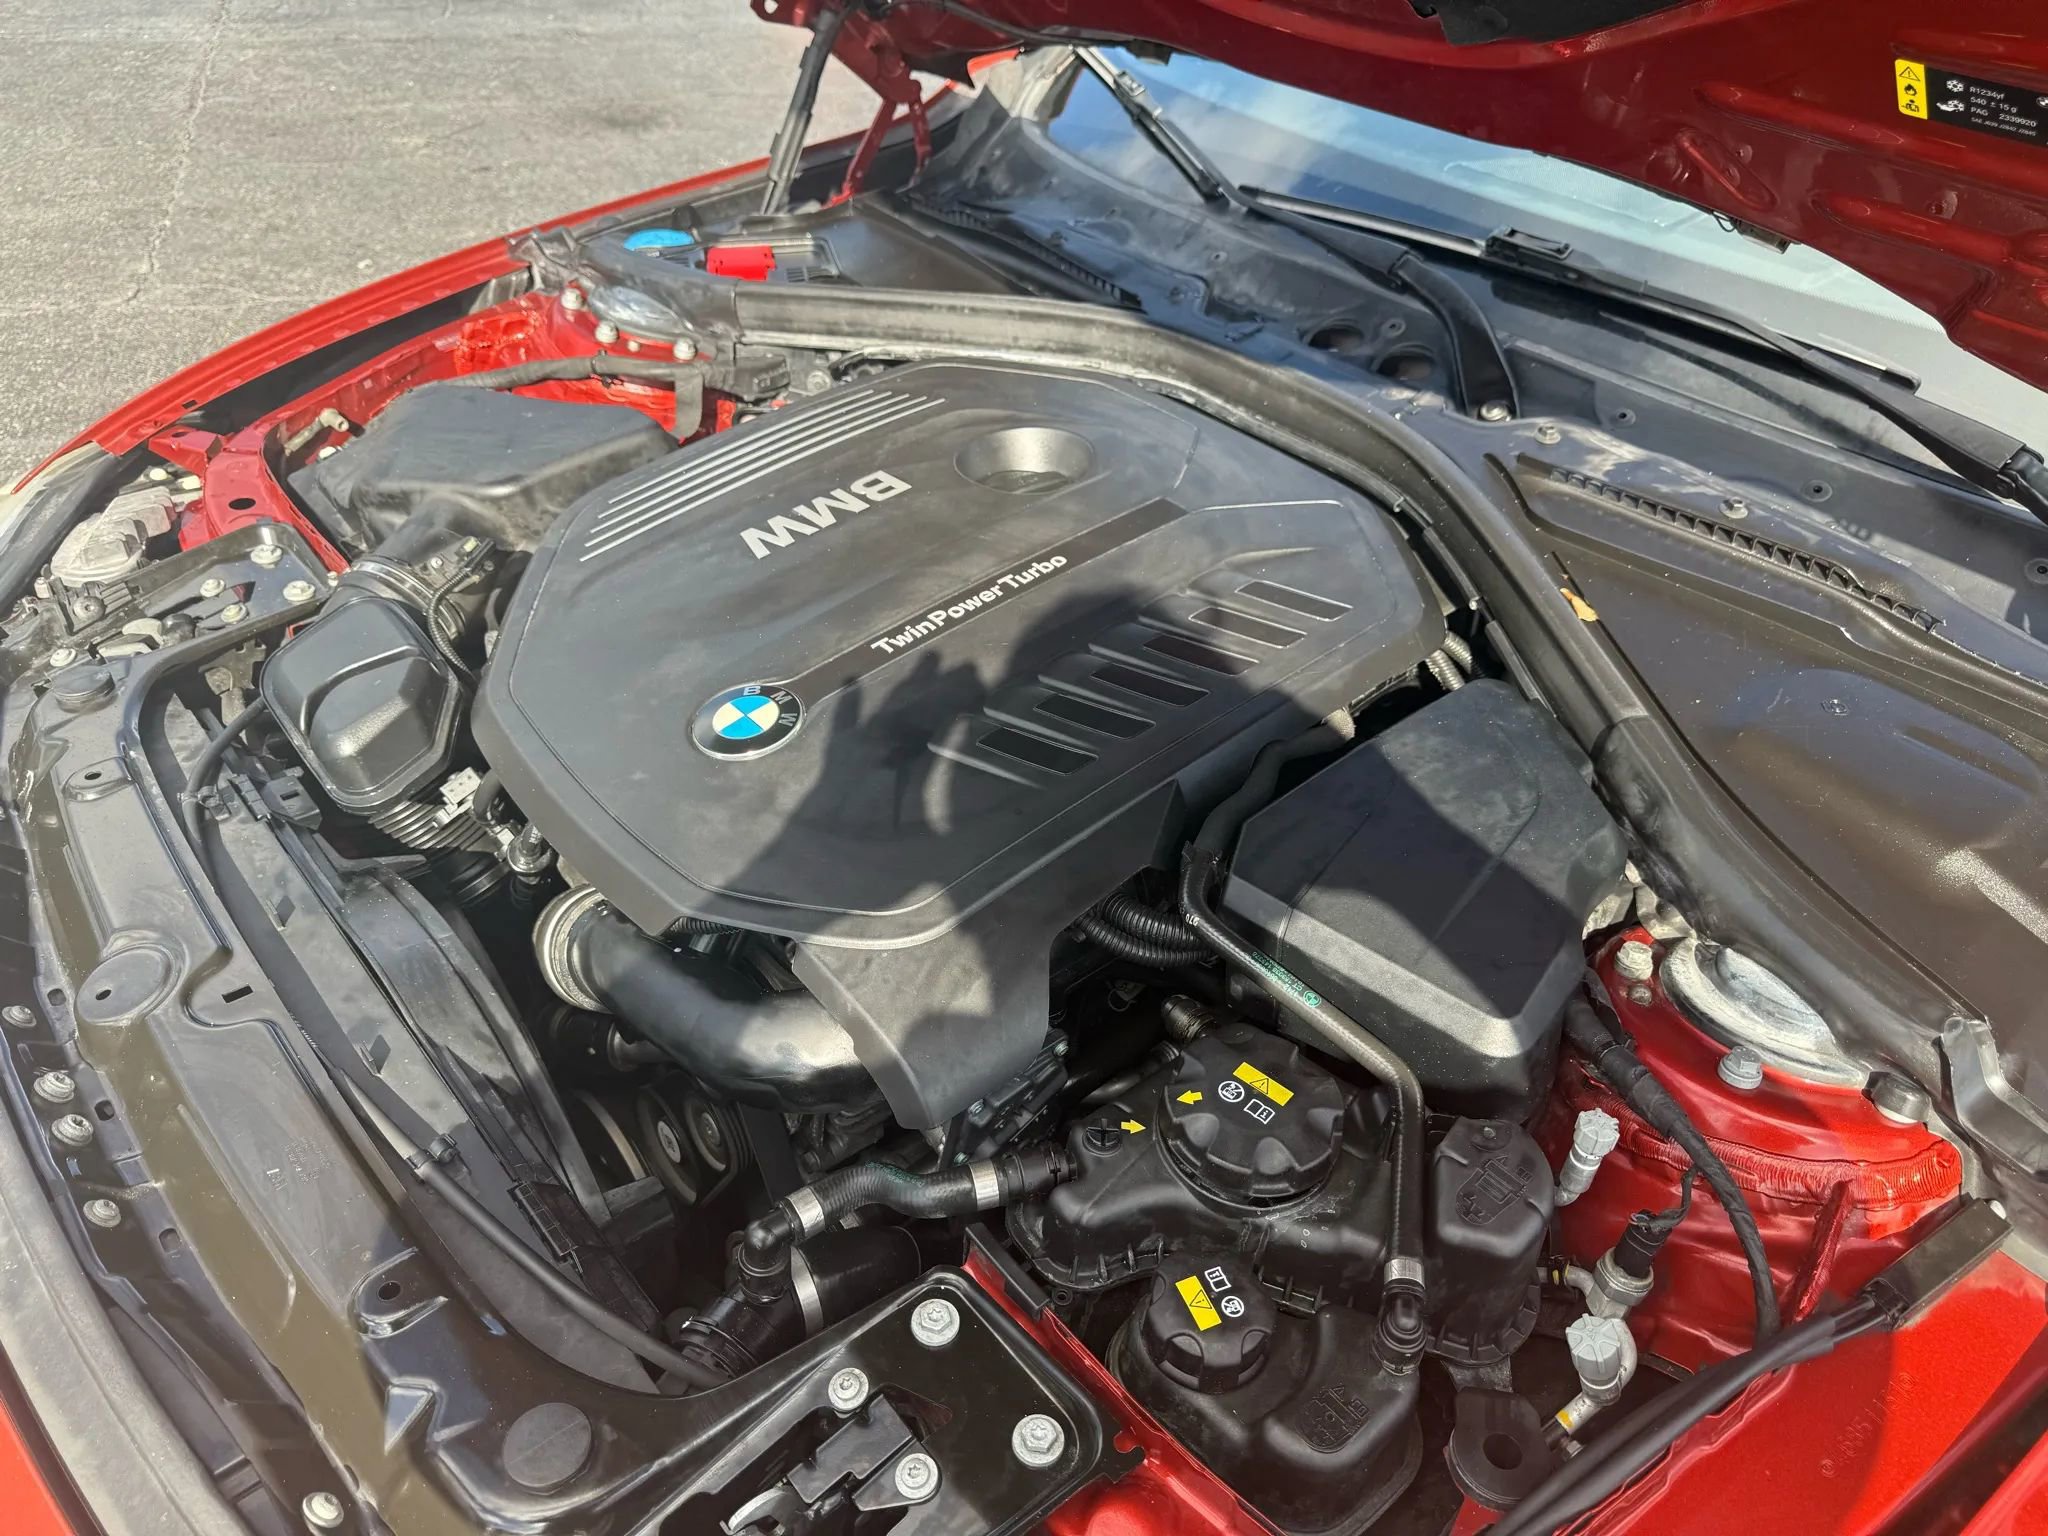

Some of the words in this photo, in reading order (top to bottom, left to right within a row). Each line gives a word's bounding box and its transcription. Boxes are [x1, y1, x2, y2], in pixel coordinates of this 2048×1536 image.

[1969, 86, 2005, 100] R1234yf
[1970, 96, 1987, 106] 540
[1999, 103, 2009, 111] 15
[1970, 106, 1988, 116] PAG
[739, 470, 912, 560] BMW
[743, 685, 799, 727] BMW
